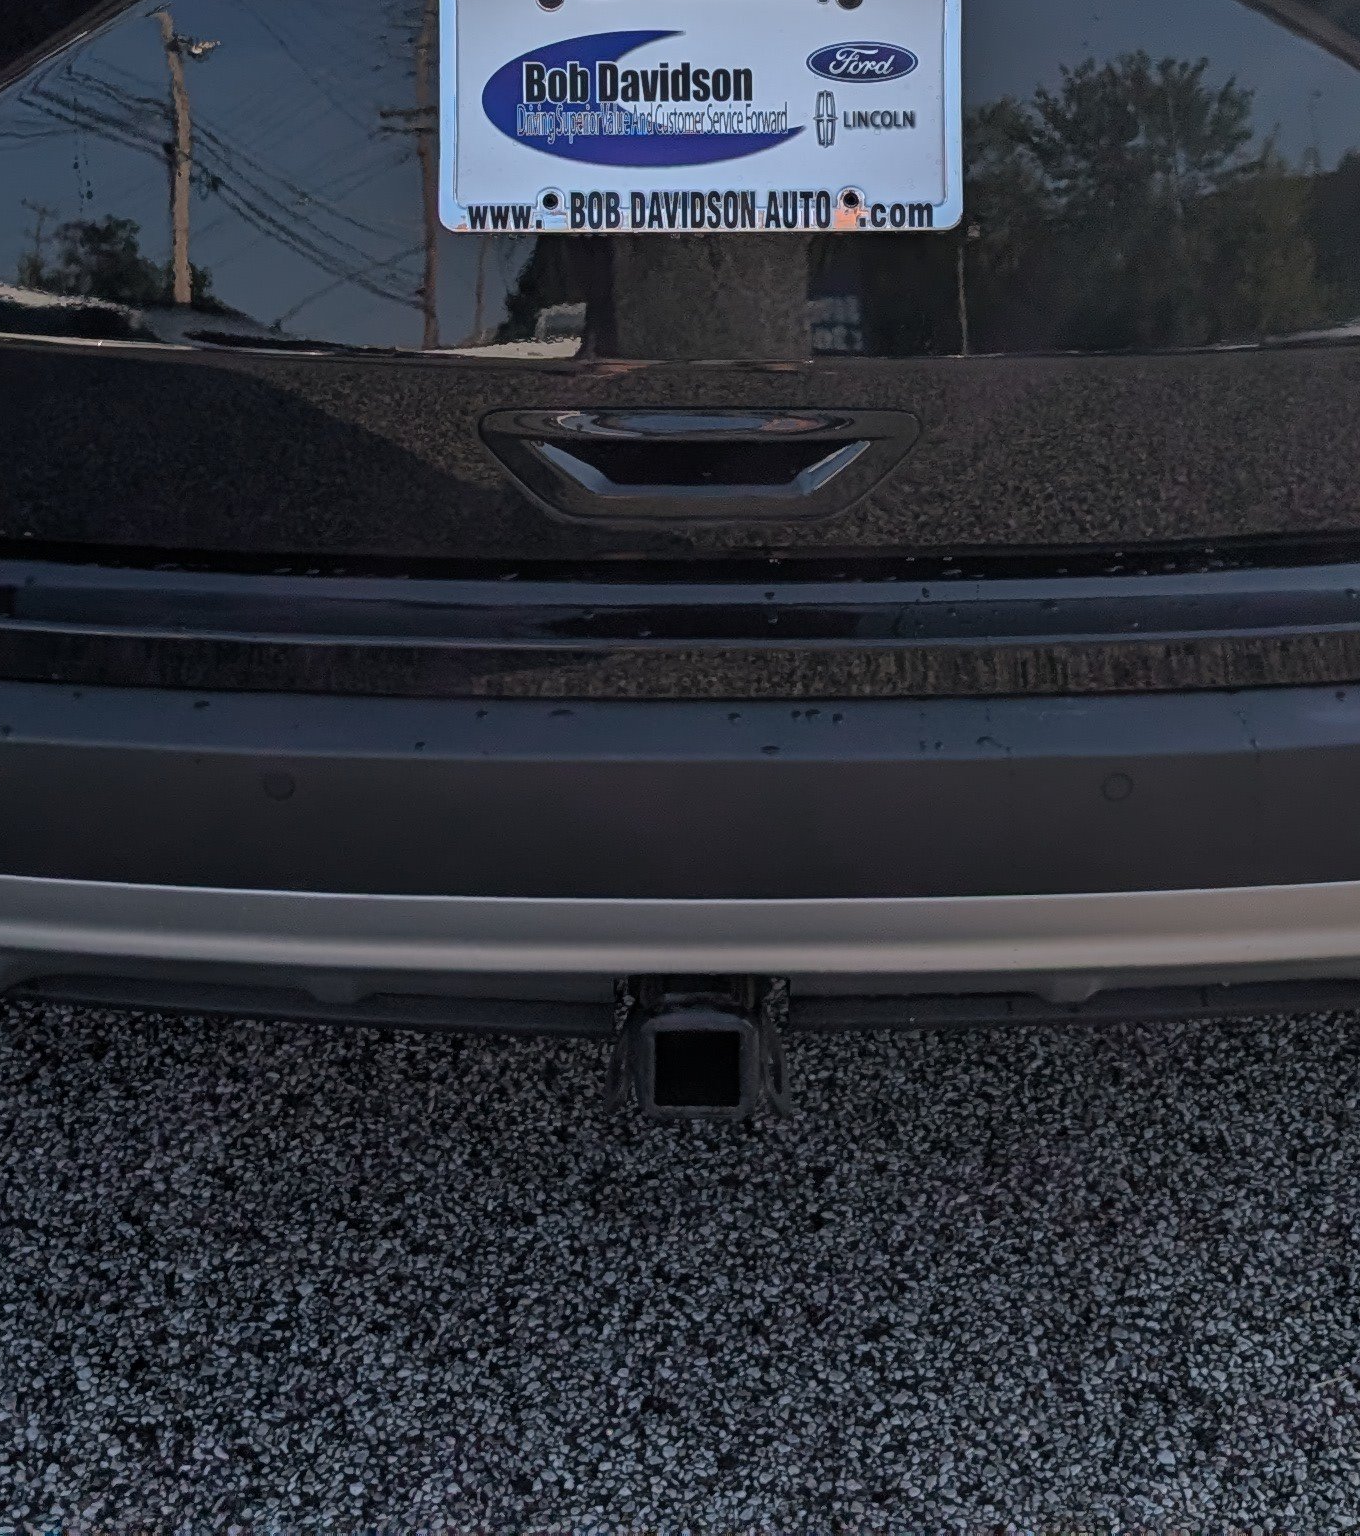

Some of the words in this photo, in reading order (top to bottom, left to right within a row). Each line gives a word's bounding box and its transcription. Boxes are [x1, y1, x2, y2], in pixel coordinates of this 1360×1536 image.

[829, 44, 896, 75] Ford
[523, 61, 590, 103] Bob
[598, 62, 754, 103] Davidson
[516, 104, 555, 144] Driving
[556, 104, 600, 145] Superior
[601, 102, 631, 136] Value
[632, 102, 654, 136] And
[655, 104, 705, 135] Customer
[706, 103, 744, 135] Service
[745, 101, 789, 135] Forward
[843, 110, 916, 129] LINCOLN
[570, 192, 621, 228] BOB
[631, 191, 757, 228] DAVIDSON
[765, 191, 831, 227] AUTO
[859, 199, 934, 228] .com
